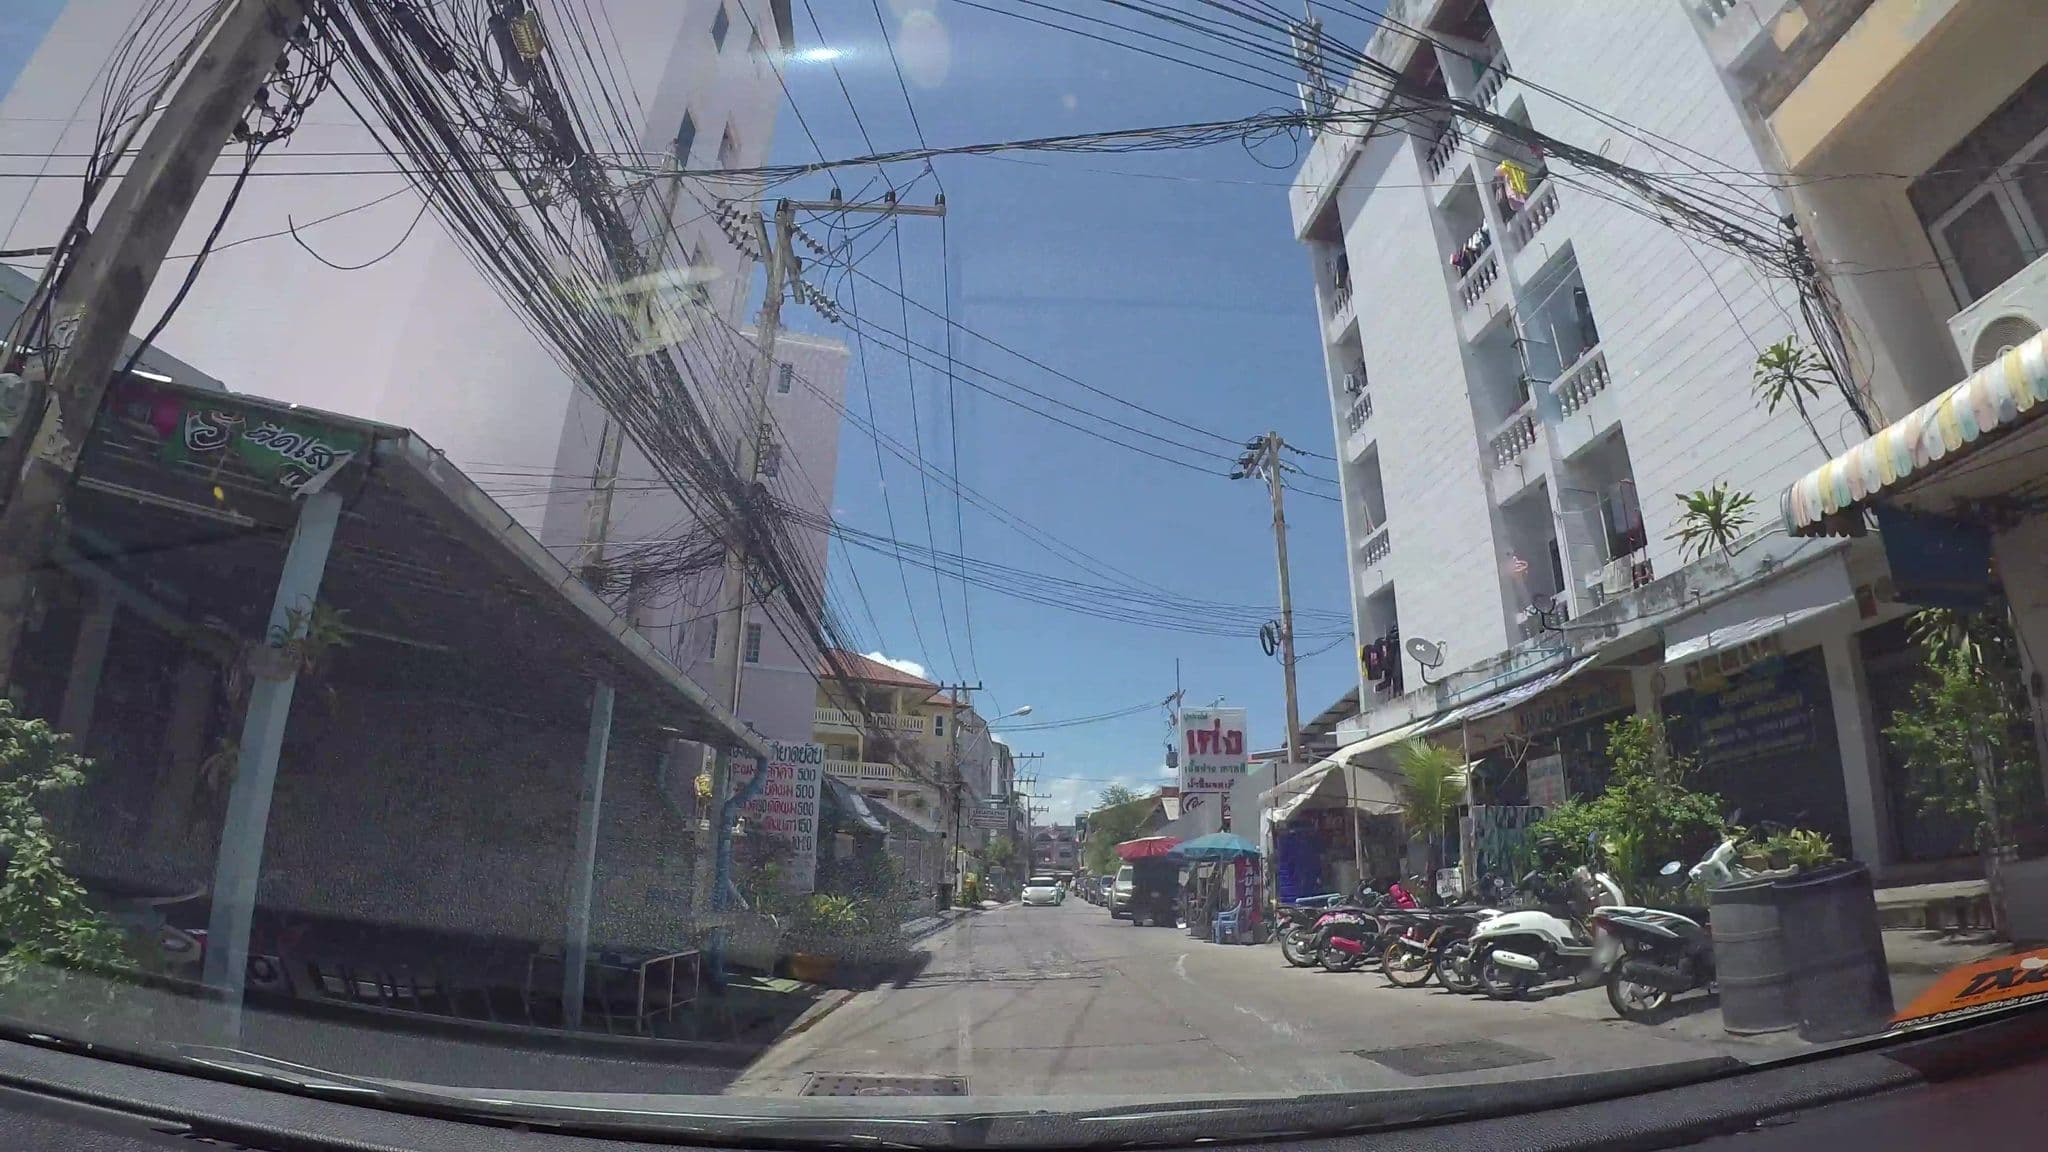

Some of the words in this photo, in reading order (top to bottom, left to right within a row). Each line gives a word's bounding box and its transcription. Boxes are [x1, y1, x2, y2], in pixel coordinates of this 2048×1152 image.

[797, 768, 816, 781] 500
[795, 784, 815, 799] 500
[797, 802, 814, 816] 500
